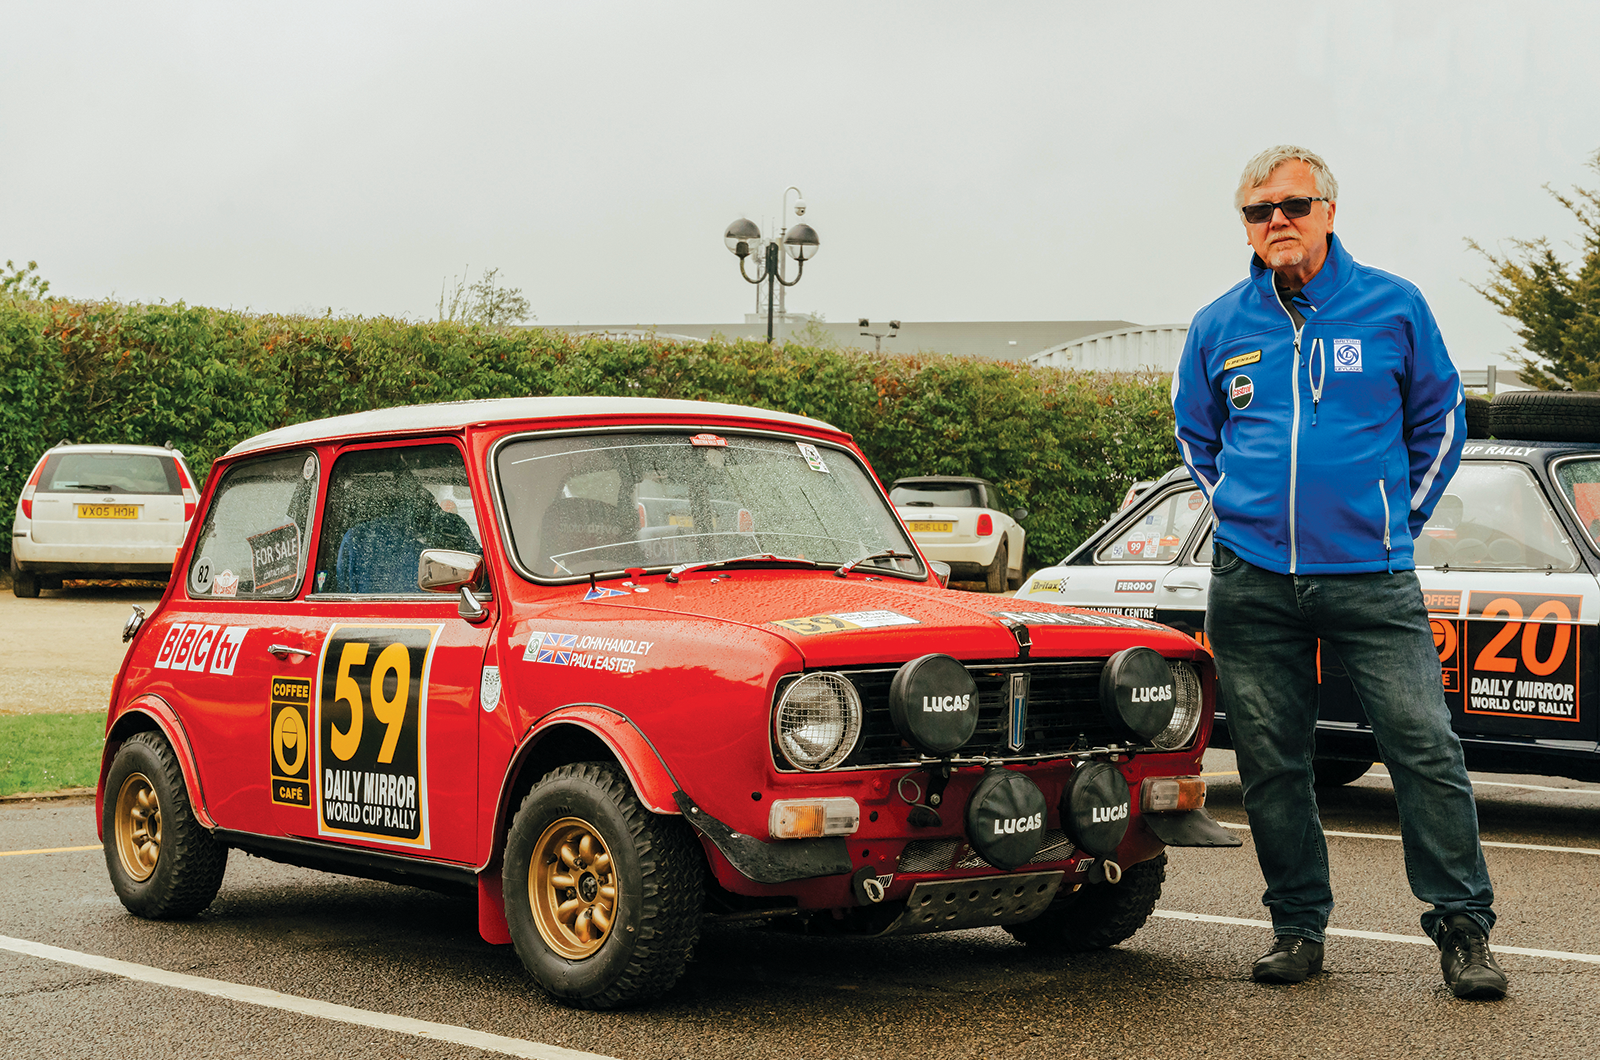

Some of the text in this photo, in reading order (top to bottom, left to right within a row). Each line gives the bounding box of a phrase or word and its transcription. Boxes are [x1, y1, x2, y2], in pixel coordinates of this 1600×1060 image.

[1230, 353, 1259, 366] DUNLOP
[1232, 384, 1252, 398] Castrol
[1461, 446, 1537, 457] UP RALLY
[81, 506, 110, 516] VX05
[913, 523, 949, 531] BG16 LLD
[255, 537, 298, 567] FOR SALE
[1130, 542, 1141, 551] 99
[197, 564, 210, 584] 82
[1032, 580, 1058, 590] Britax
[1116, 581, 1154, 591] FERODO
[1423, 593, 1460, 607] OFFEE
[1124, 608, 1154, 619] CENTRE
[784, 616, 846, 633] 59
[576, 635, 654, 656] JOHN HANDLEY
[1473, 597, 1572, 677] 20
[158, 626, 240, 671] BBC tv
[569, 652, 636, 674] PAUL EASTER
[273, 683, 309, 699] COFFEE
[1131, 684, 1172, 703] LUCAS
[1470, 677, 1513, 697] DAILY
[1515, 680, 1575, 702] MIRROR
[330, 642, 411, 764] 59
[922, 693, 970, 713] LUCAS
[1470, 696, 1574, 716] WORLD CUP RALLY
[279, 786, 303, 801] CAFÉ
[324, 768, 416, 809] DAILY MIRROR
[325, 801, 417, 831] WORLD CUP RALLY
[1092, 802, 1128, 823] LUCAS
[993, 812, 1042, 835] LUCAS
[876, 875, 893, 888] OW
